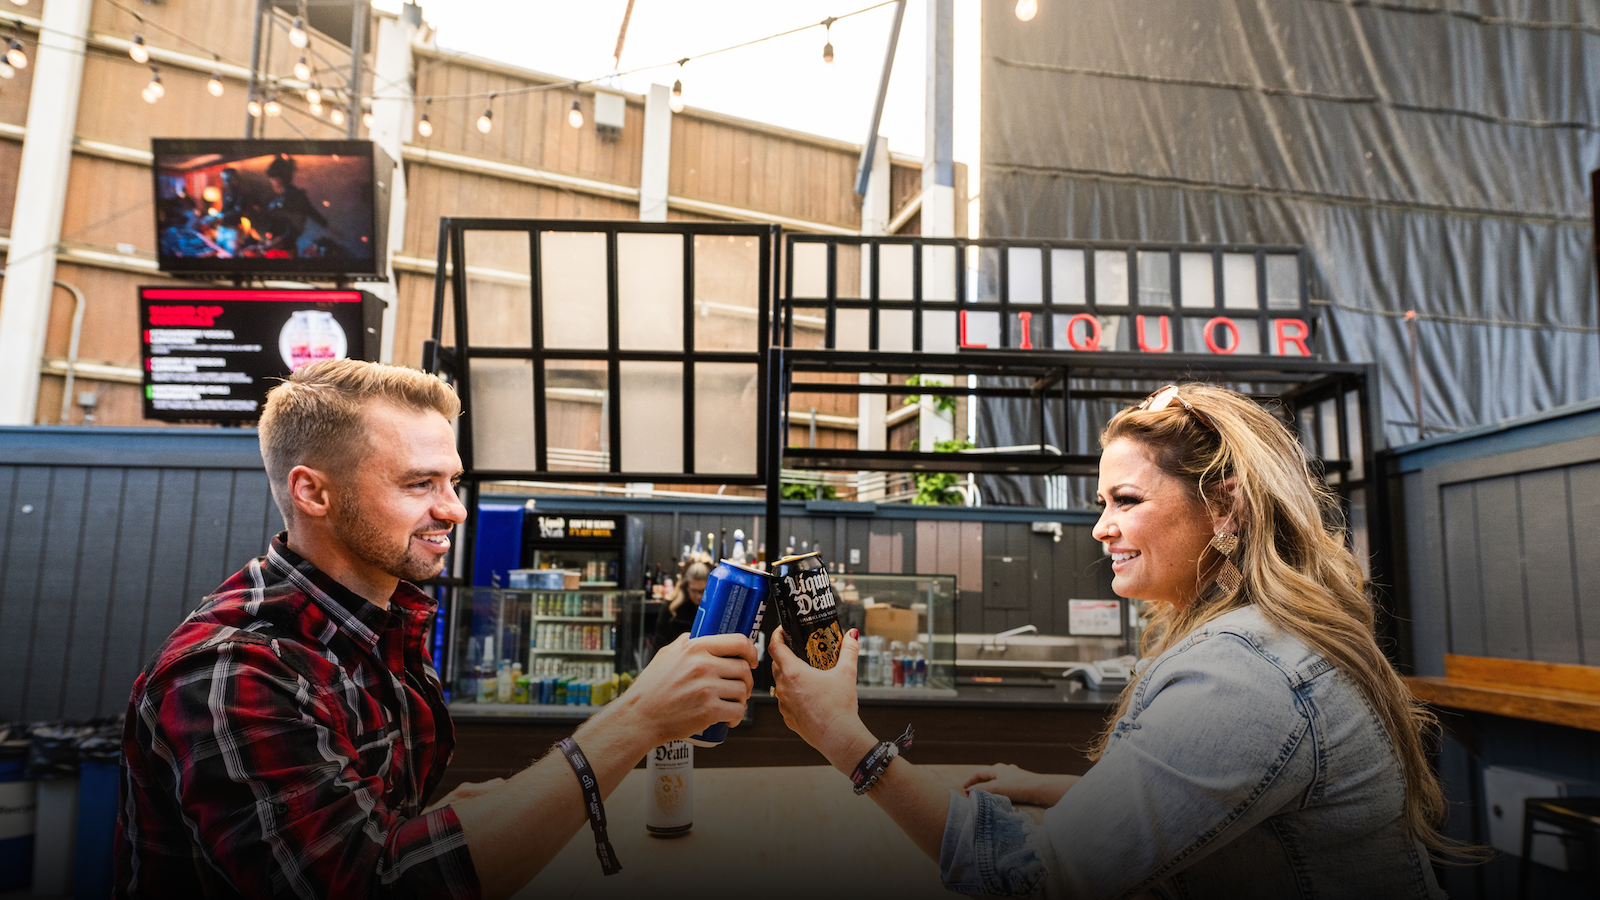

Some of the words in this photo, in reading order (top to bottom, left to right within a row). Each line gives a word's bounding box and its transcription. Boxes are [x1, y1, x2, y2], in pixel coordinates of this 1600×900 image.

[959, 310, 1312, 356] LIQUOR
[784, 567, 830, 597] Liquid
[794, 588, 836, 616] Death
[749, 600, 767, 644] GHT
[654, 743, 690, 761] Death
[582, 774, 595, 790] citi
